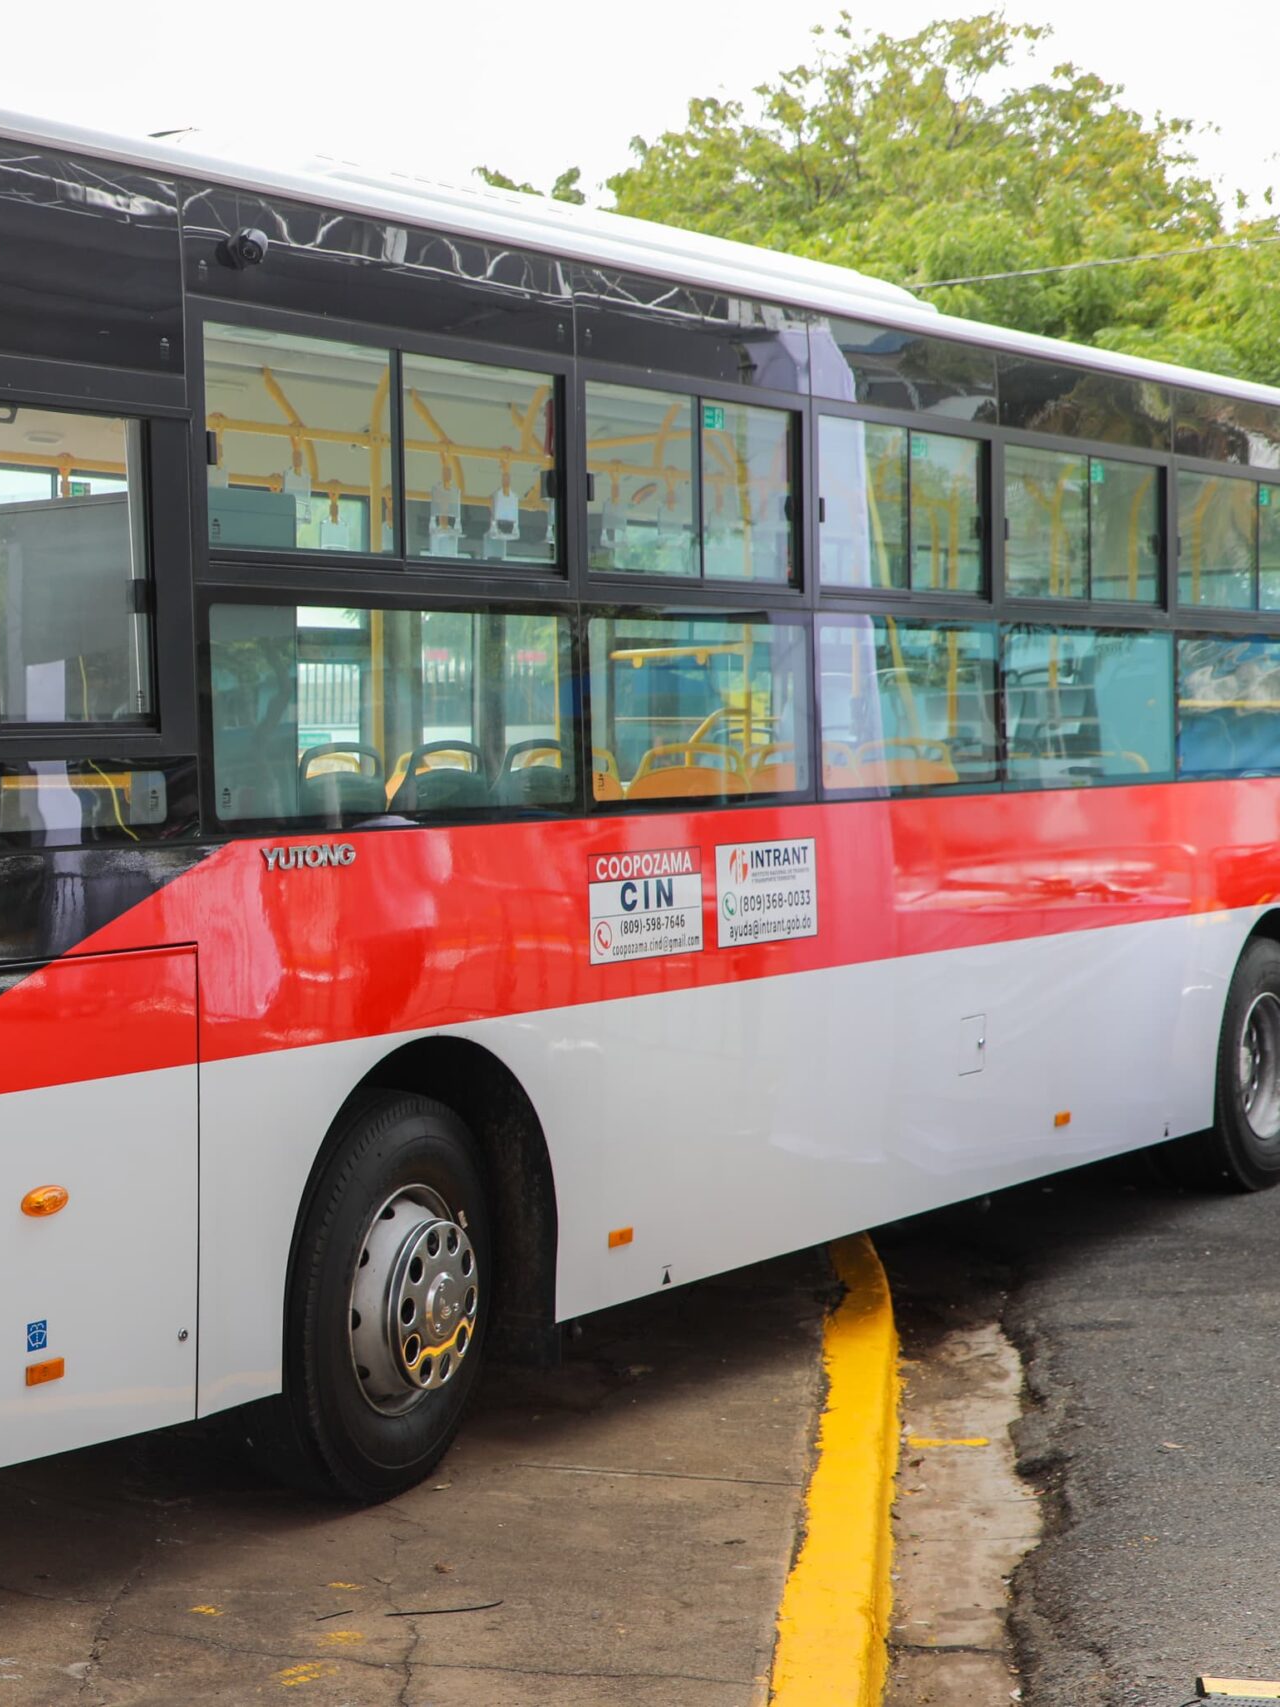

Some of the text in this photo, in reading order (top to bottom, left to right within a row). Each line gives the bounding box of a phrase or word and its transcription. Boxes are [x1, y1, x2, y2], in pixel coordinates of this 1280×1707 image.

[261, 843, 356, 871] YUTONG
[596, 851, 692, 880] COOPOZAMA
[750, 846, 808, 869] INTRANT
[620, 878, 674, 912] CIN
[739, 889, 811, 917] (809)368-0033
[620, 914, 686, 936] (809)-598-7646
[729, 914, 812, 942] ayuda@intrant.gob.do
[612, 934, 700, 958] coopozama.cind@gmail.com
